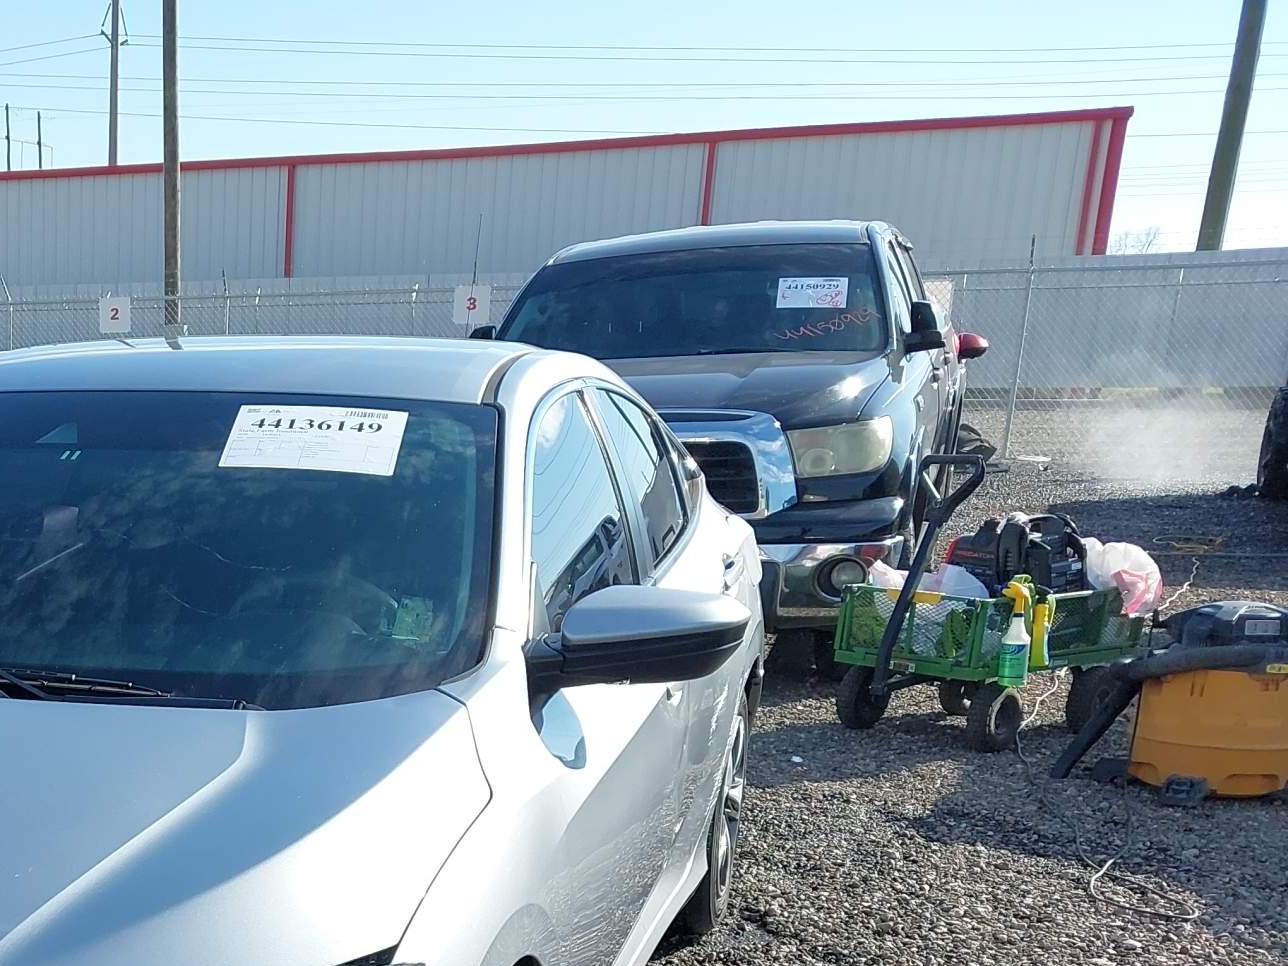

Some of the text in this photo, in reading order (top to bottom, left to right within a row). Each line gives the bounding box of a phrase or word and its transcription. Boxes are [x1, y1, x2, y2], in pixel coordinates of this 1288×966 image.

[466, 297, 477, 311] 3
[110, 307, 120, 321] 2
[250, 417, 383, 434] 44136149
